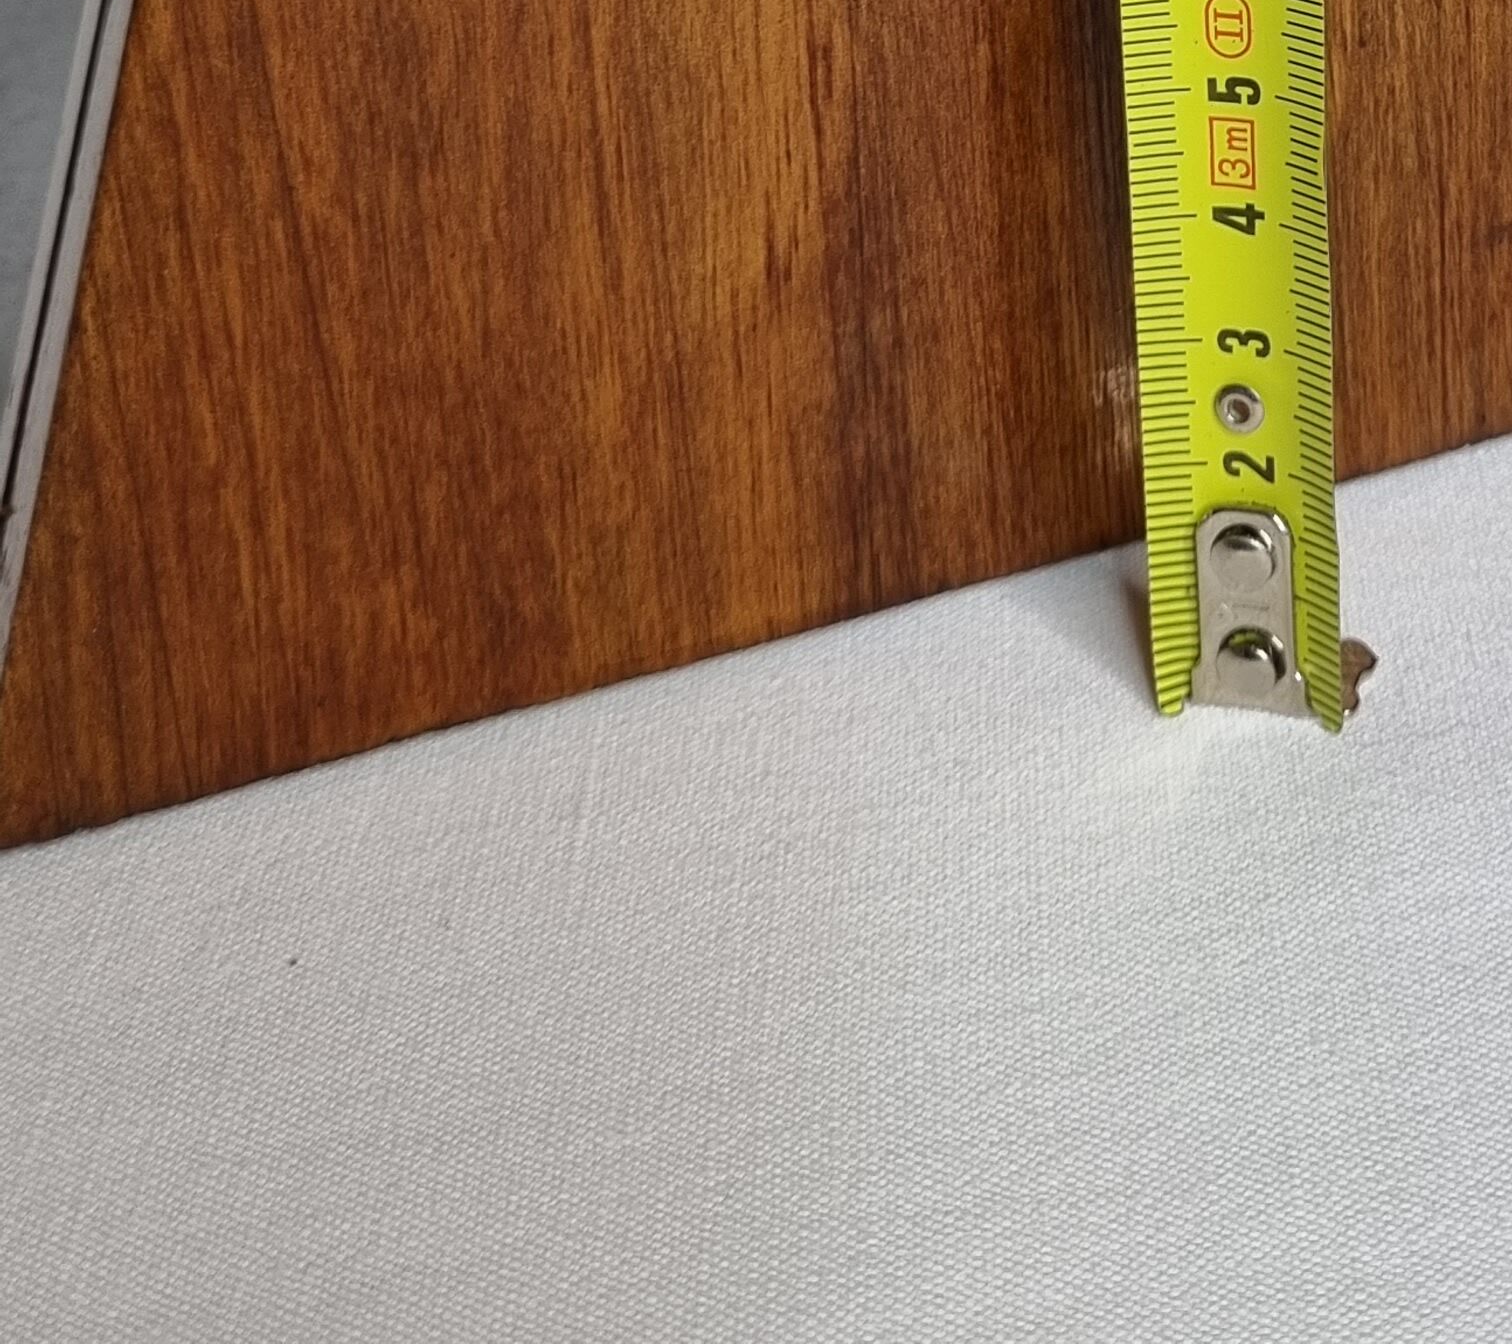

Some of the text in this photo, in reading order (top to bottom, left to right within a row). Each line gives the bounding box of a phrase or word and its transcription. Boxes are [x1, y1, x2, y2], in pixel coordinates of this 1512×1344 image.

[1213, 7, 1244, 43] II
[1207, 76, 1261, 106] 5
[1212, 203, 1266, 236] 4
[1216, 329, 1271, 358] 3
[1222, 451, 1275, 484] 2
